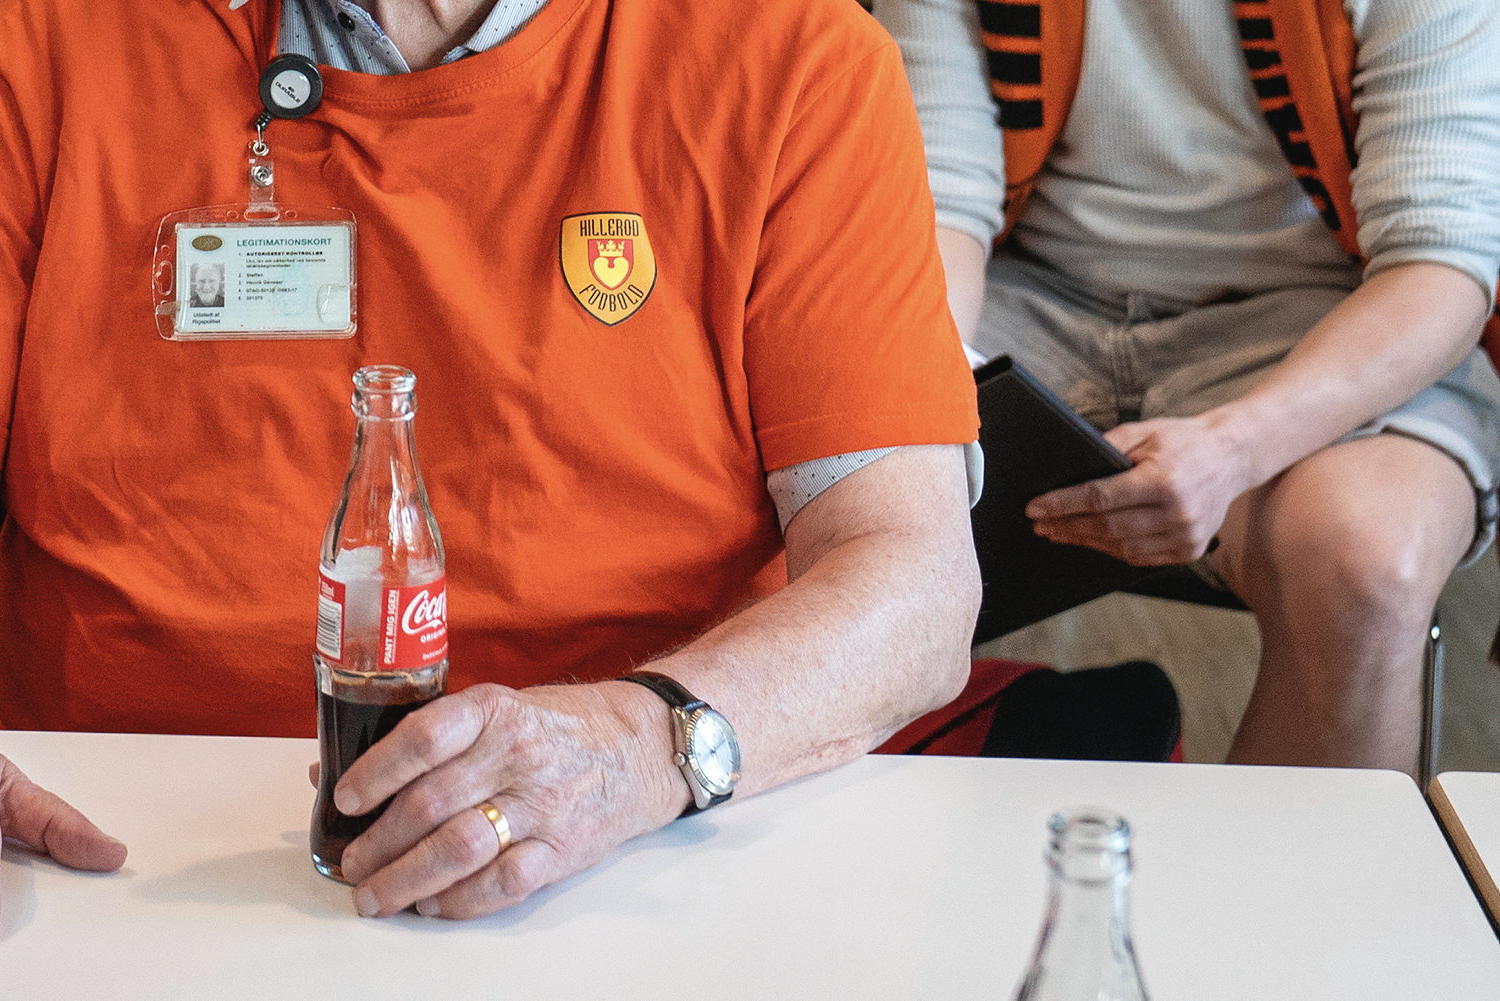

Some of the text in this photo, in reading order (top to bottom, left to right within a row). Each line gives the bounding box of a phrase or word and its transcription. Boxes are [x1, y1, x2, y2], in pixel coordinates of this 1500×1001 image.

[275, 81, 301, 103] DURABLE
[236, 238, 332, 247] LEGITIMATIONSKORT
[579, 284, 644, 312] FODBOLD
[387, 590, 396, 614] IGEN
[386, 616, 395, 635] MIG
[384, 637, 393, 664] PANT
